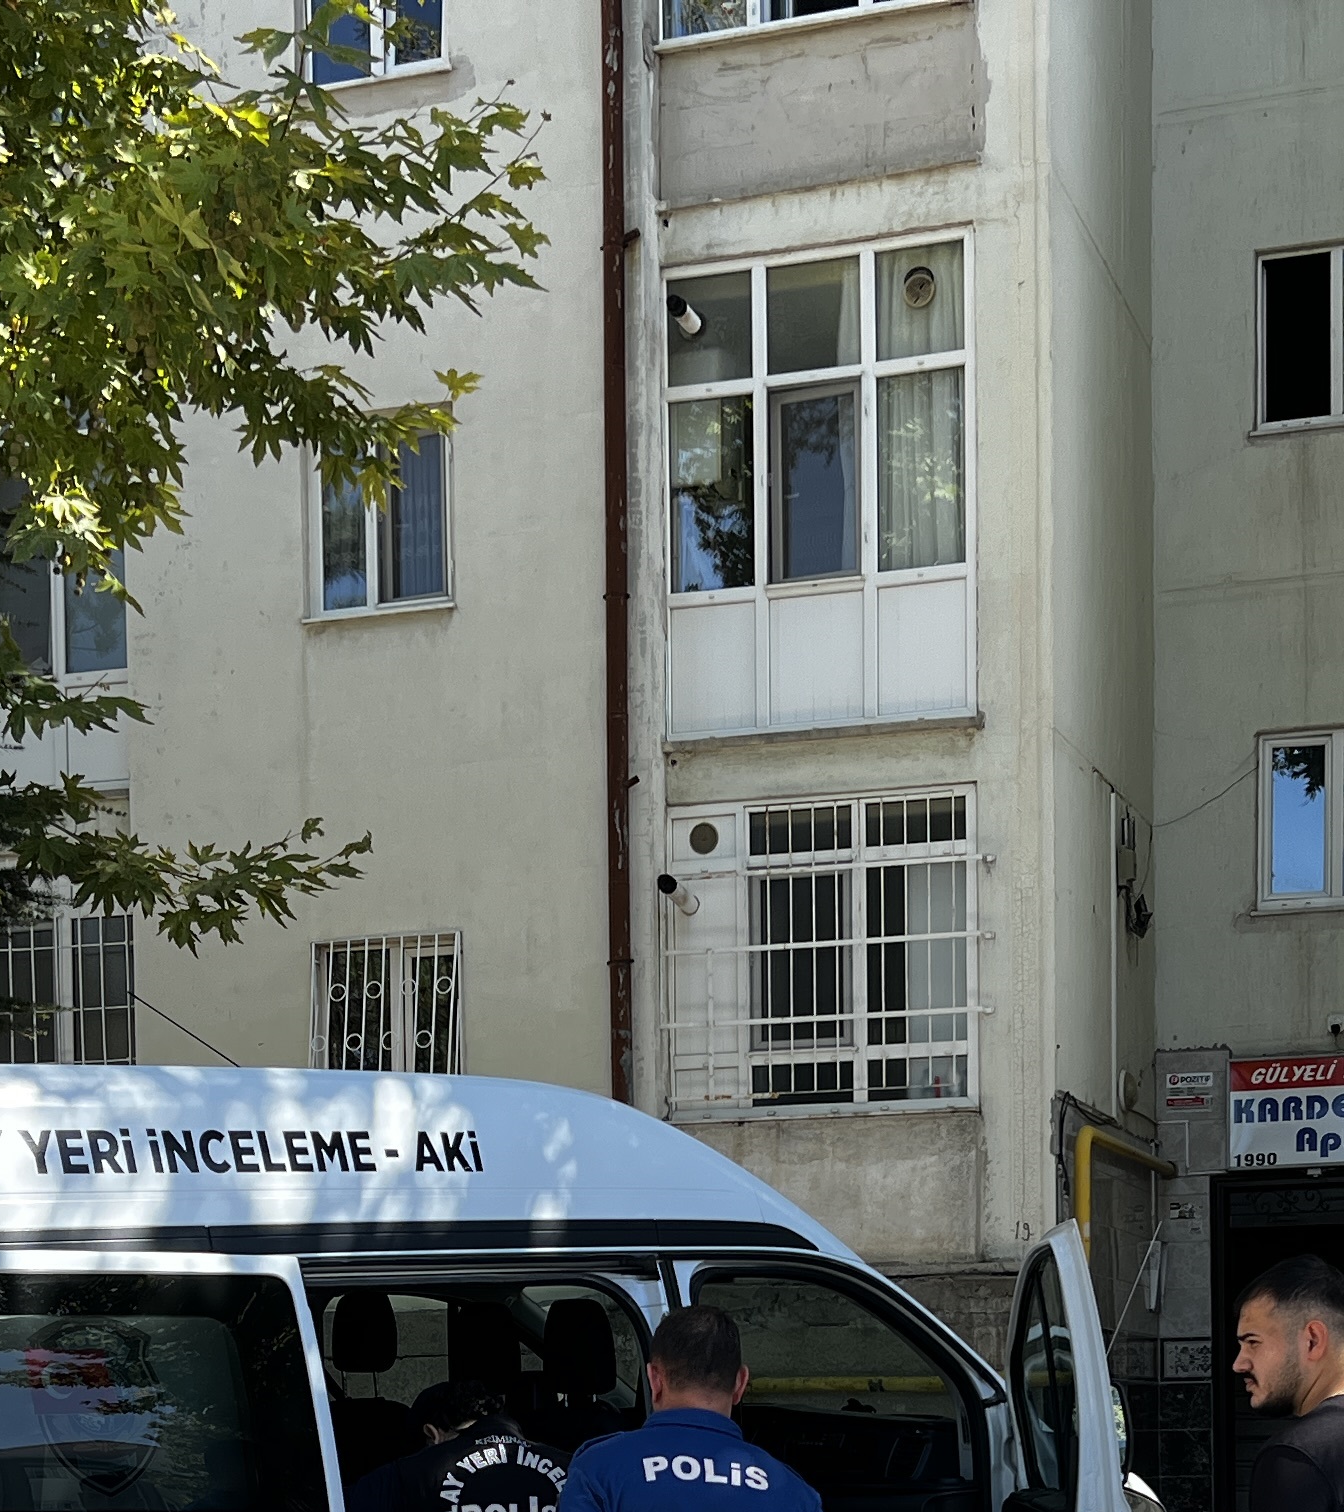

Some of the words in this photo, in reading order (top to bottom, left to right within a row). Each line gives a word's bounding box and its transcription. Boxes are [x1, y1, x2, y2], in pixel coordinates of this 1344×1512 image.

[1250, 1059, 1338, 1085] GÜLYELİ
[17, 1127, 138, 1175] YERİ
[148, 1128, 377, 1174] İNCELEME
[415, 1130, 484, 1173] AKİ
[1233, 1152, 1278, 1167] 1990
[642, 1454, 769, 1491] POLİS
